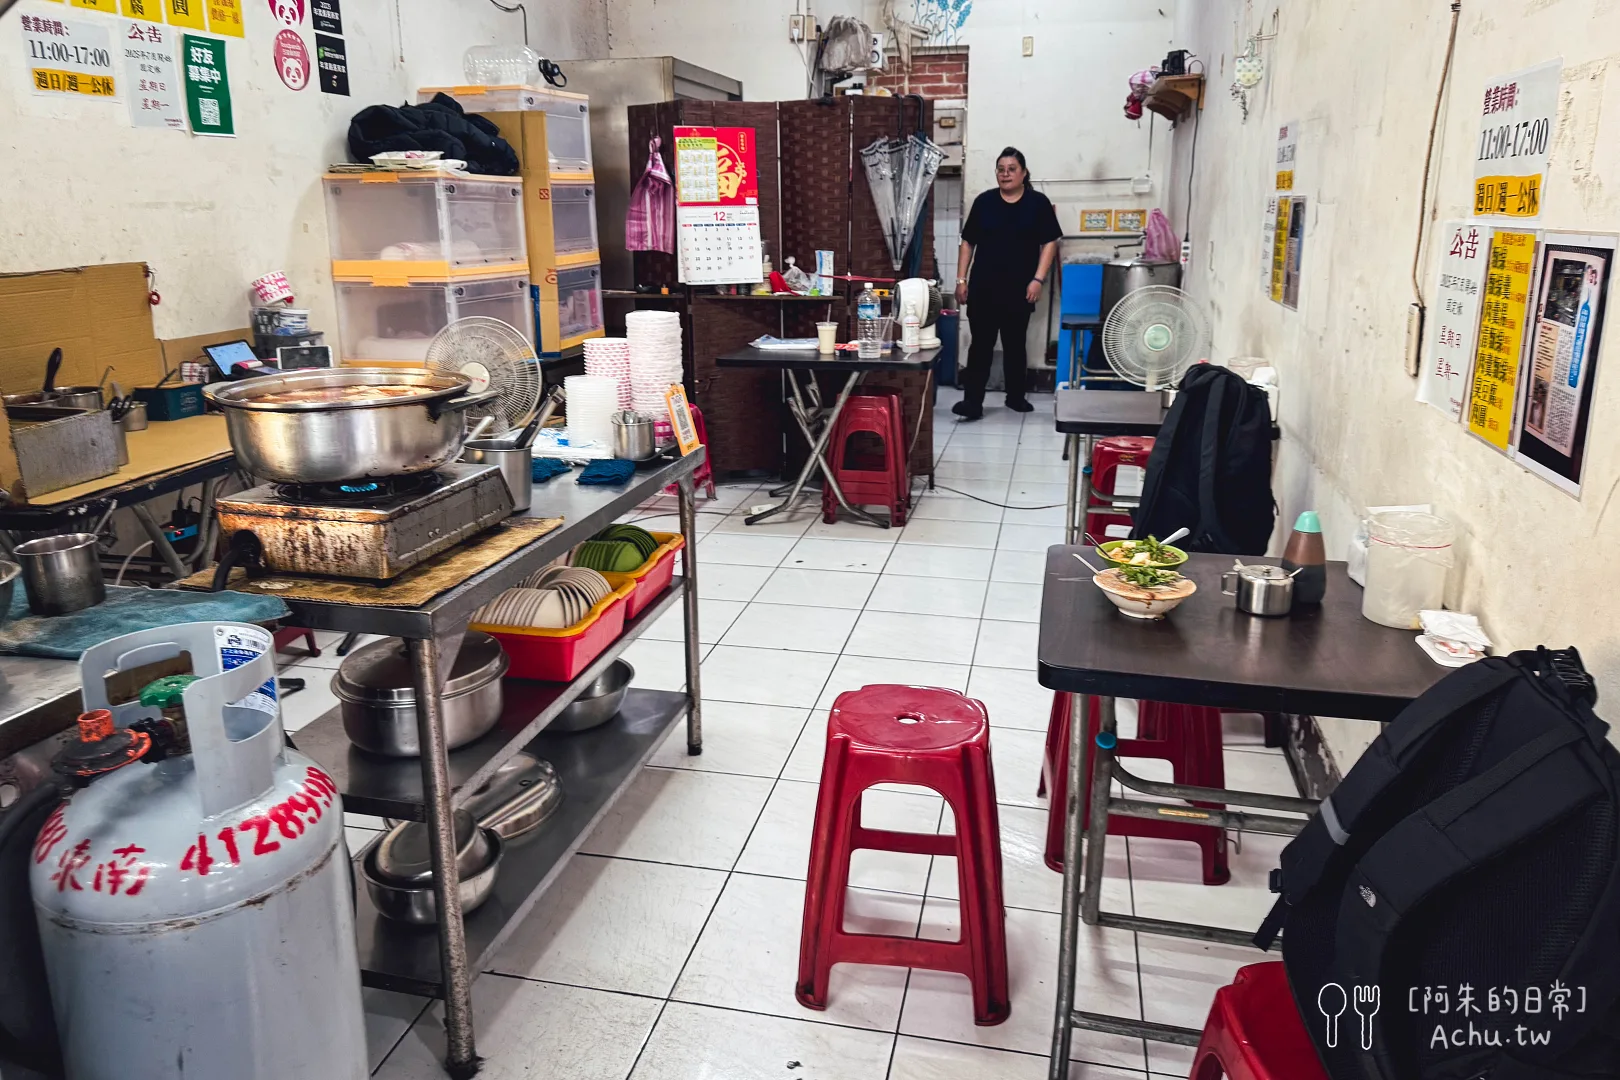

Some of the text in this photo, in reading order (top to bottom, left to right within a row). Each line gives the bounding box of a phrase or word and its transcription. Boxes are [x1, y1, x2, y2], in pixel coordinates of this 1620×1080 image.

[127, 22, 163, 44] 公告
[28, 39, 110, 68] 11:00-17:00
[190, 46, 215, 65] 好友
[138, 78, 167, 93] 星期日
[141, 97, 170, 111] 星期一
[1478, 118, 1549, 161] 11:00-17:00
[713, 211, 726, 221] 12
[1449, 227, 1479, 260] 公告
